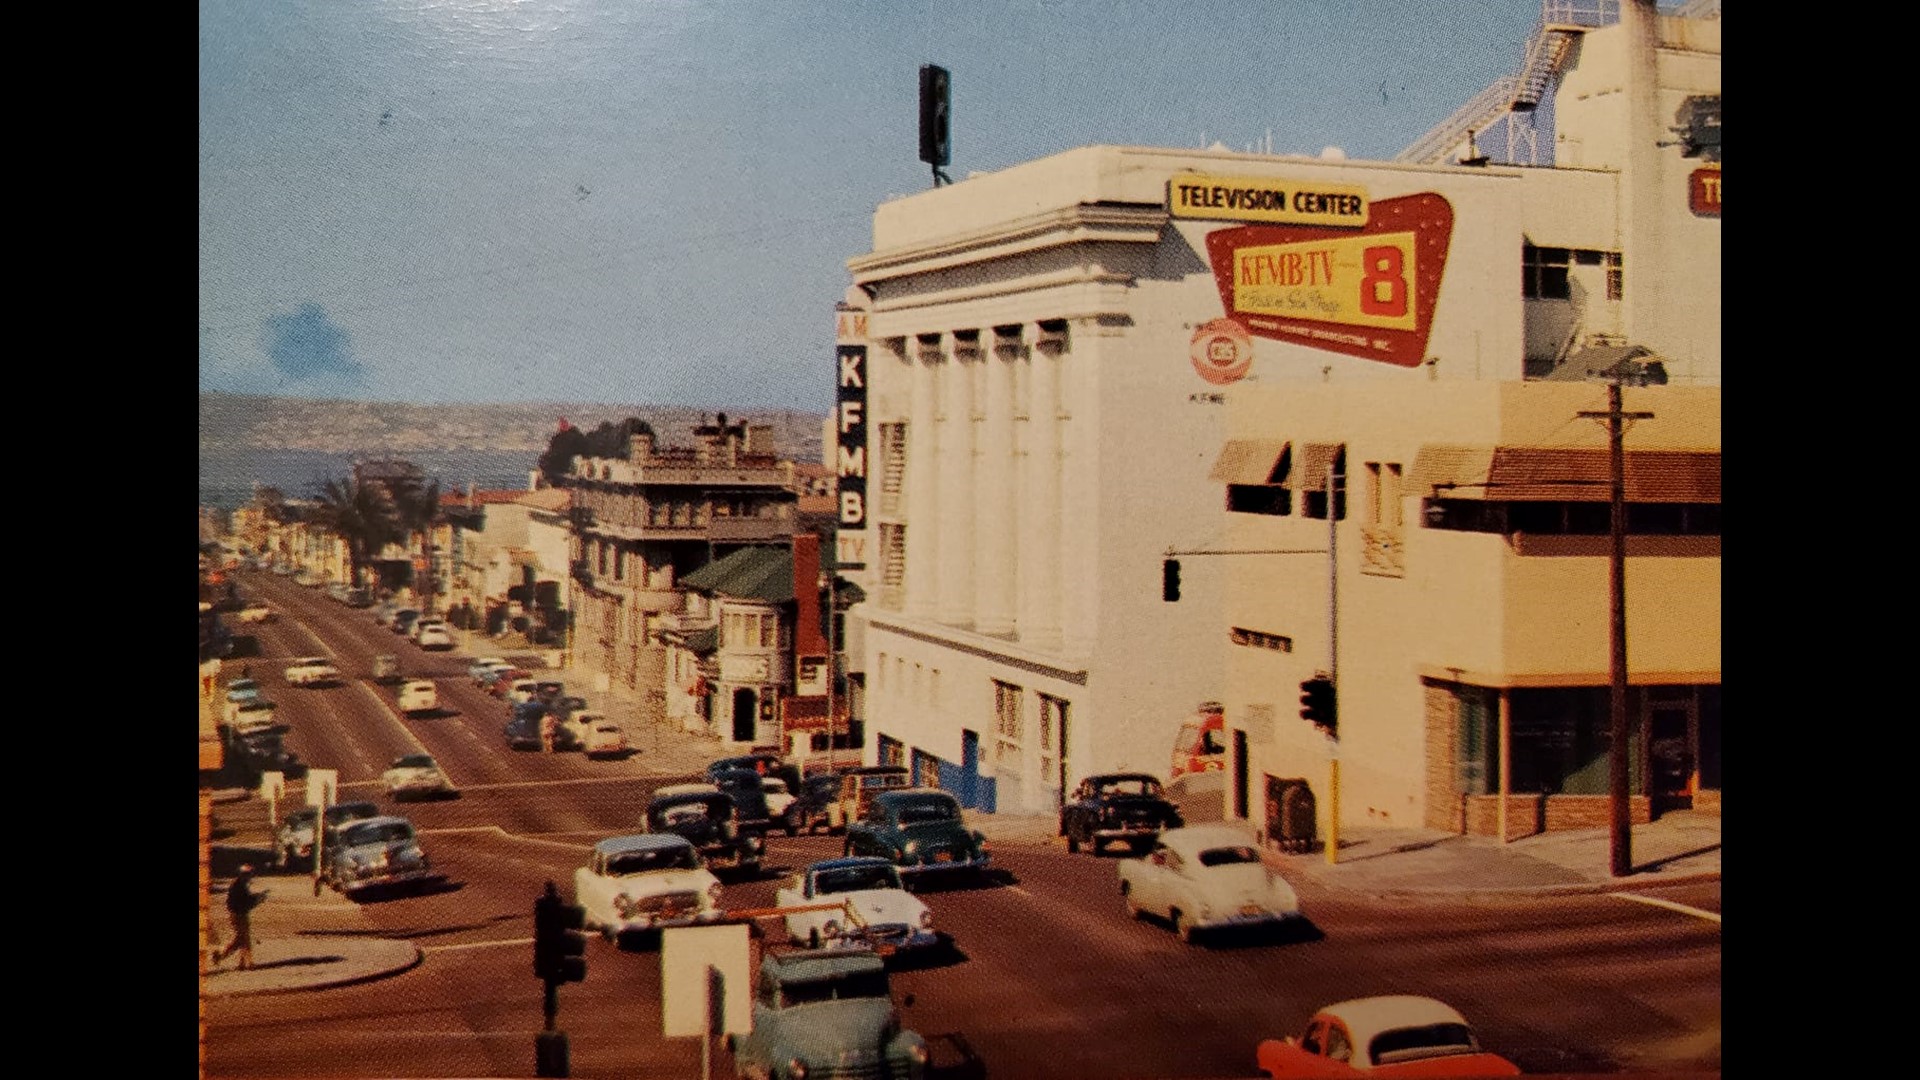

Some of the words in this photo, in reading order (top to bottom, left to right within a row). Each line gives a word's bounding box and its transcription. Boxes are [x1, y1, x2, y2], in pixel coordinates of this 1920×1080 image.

[1178, 185, 1285, 211] TELEVISION
[1293, 191, 1362, 216] CENTER
[1360, 245, 1408, 317] 8
[840, 355, 864, 523] KFMB
[839, 536, 866, 561] TV
